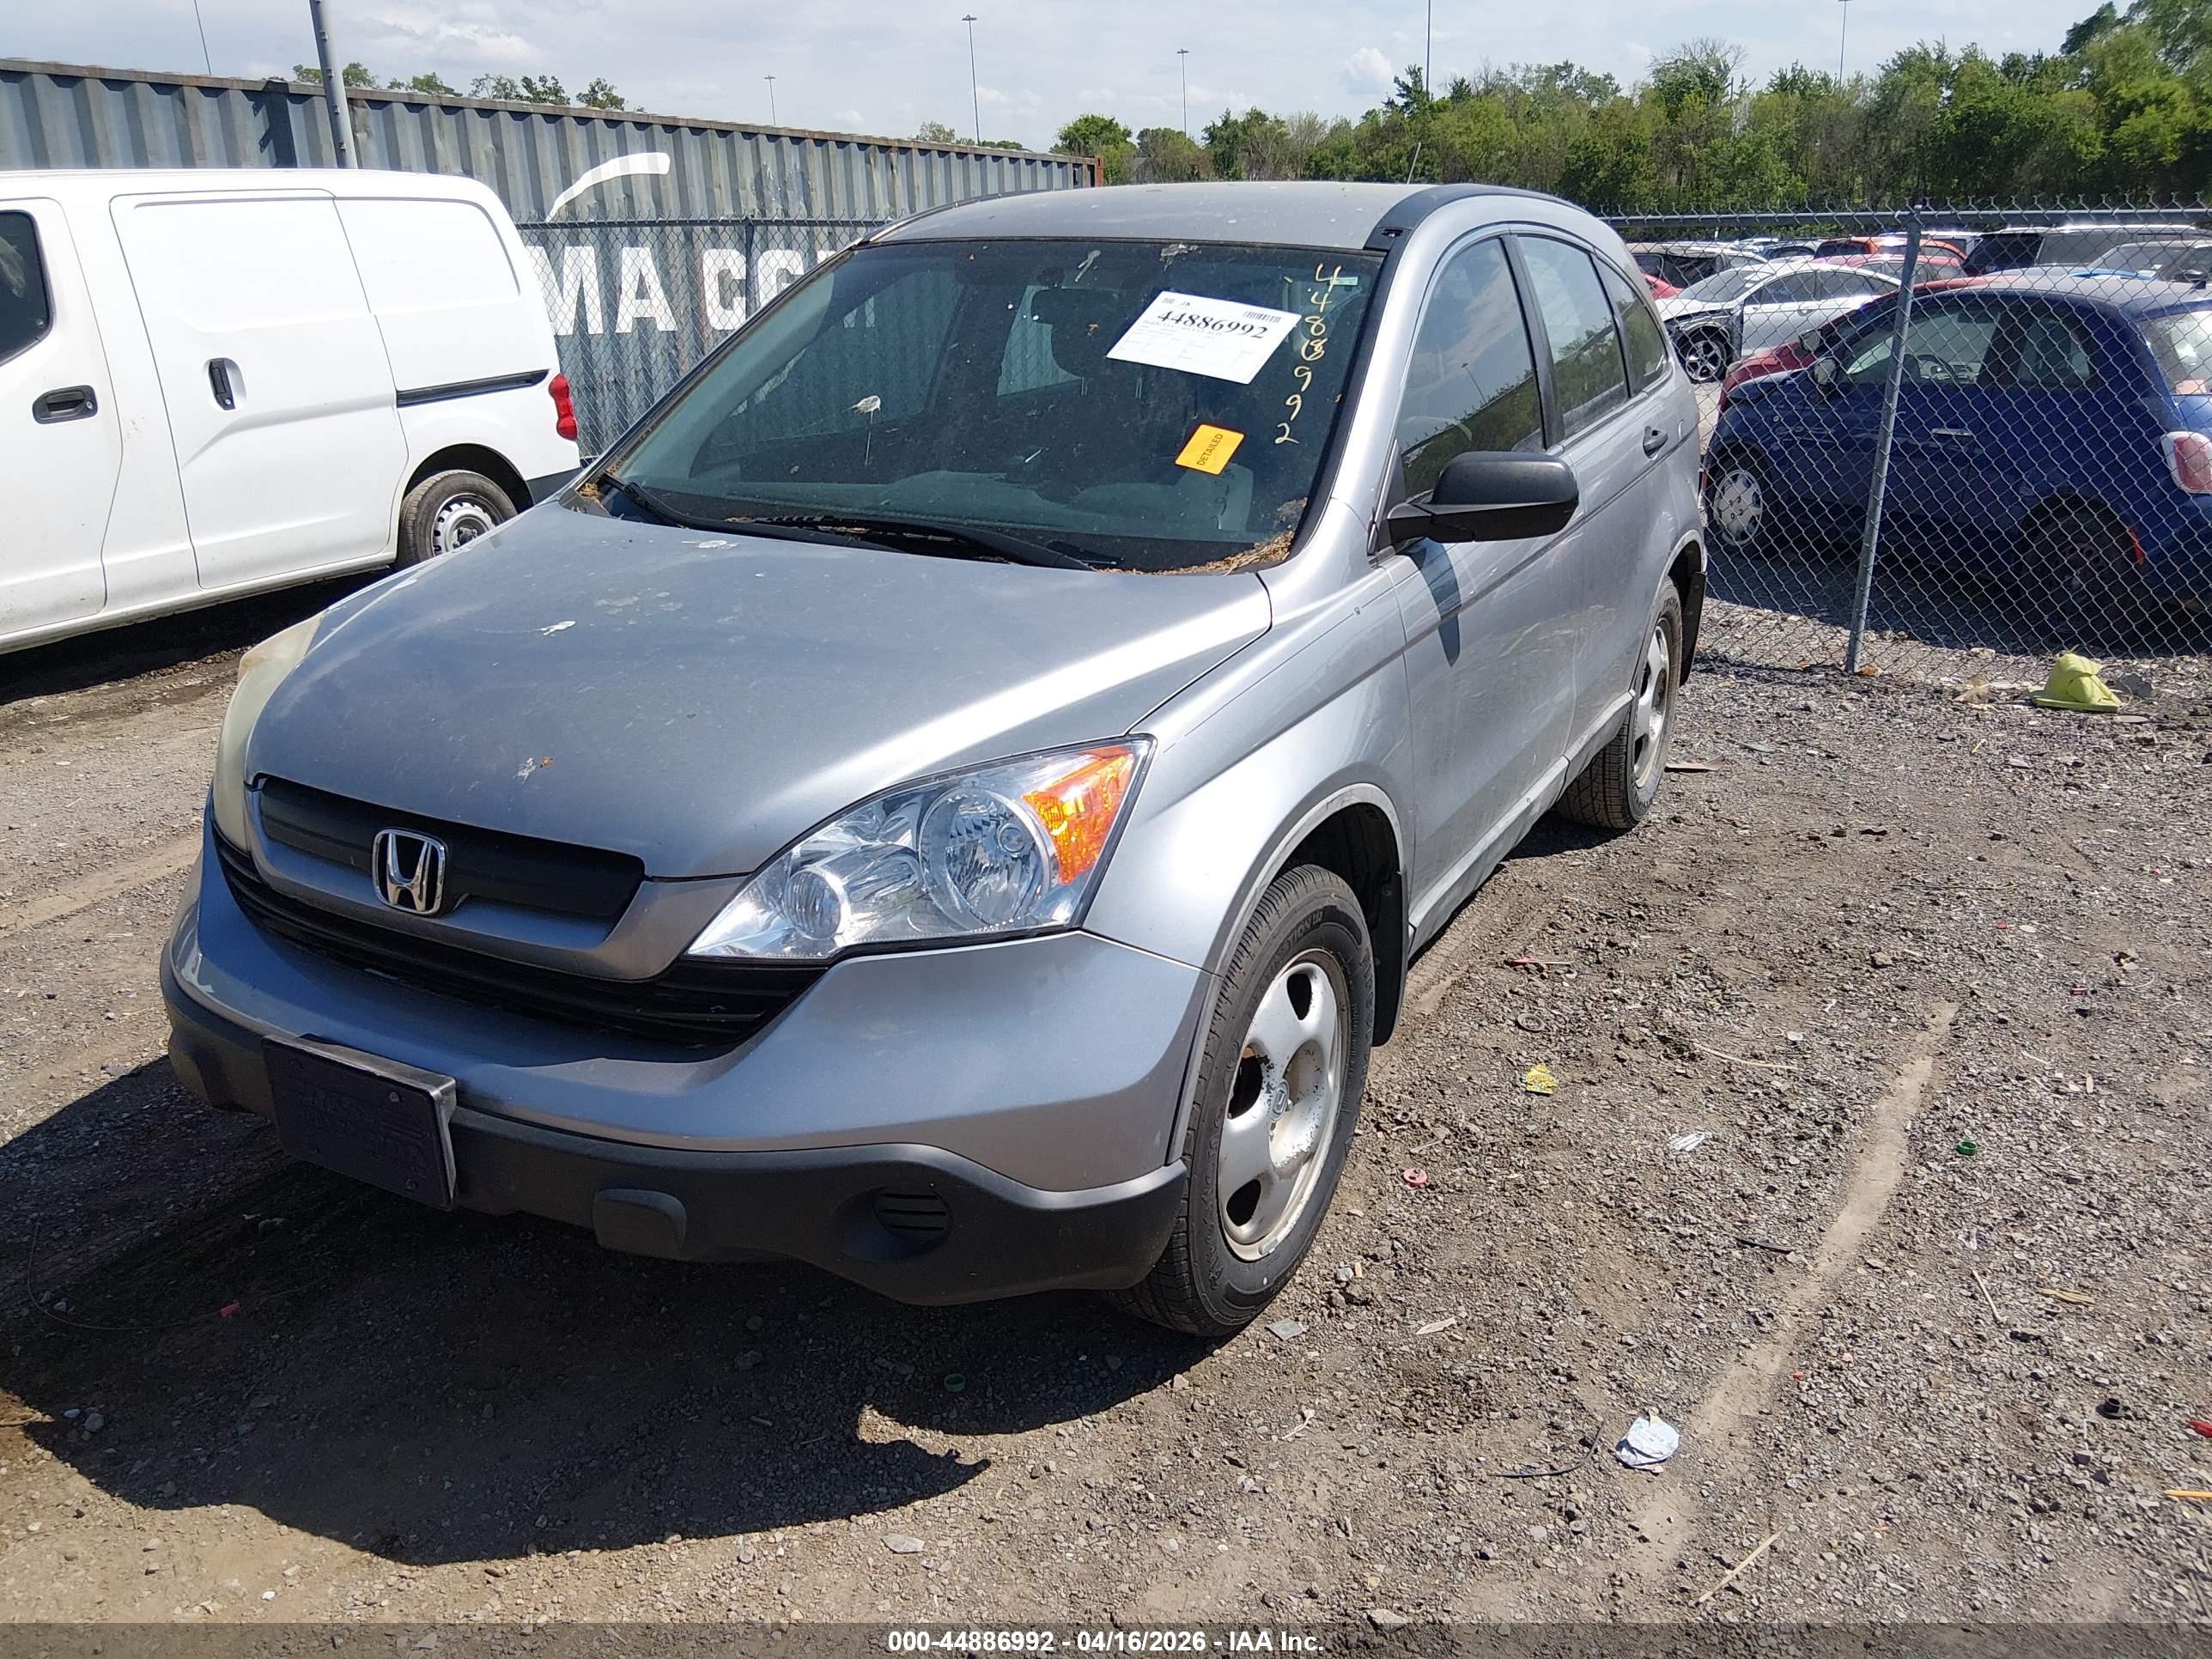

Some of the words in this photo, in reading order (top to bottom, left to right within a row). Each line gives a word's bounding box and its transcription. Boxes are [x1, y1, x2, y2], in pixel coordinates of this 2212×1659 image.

[702, 247, 838, 331] CG
[1157, 309, 1268, 340] 44886992
[1196, 433, 1224, 467] DETAILED
